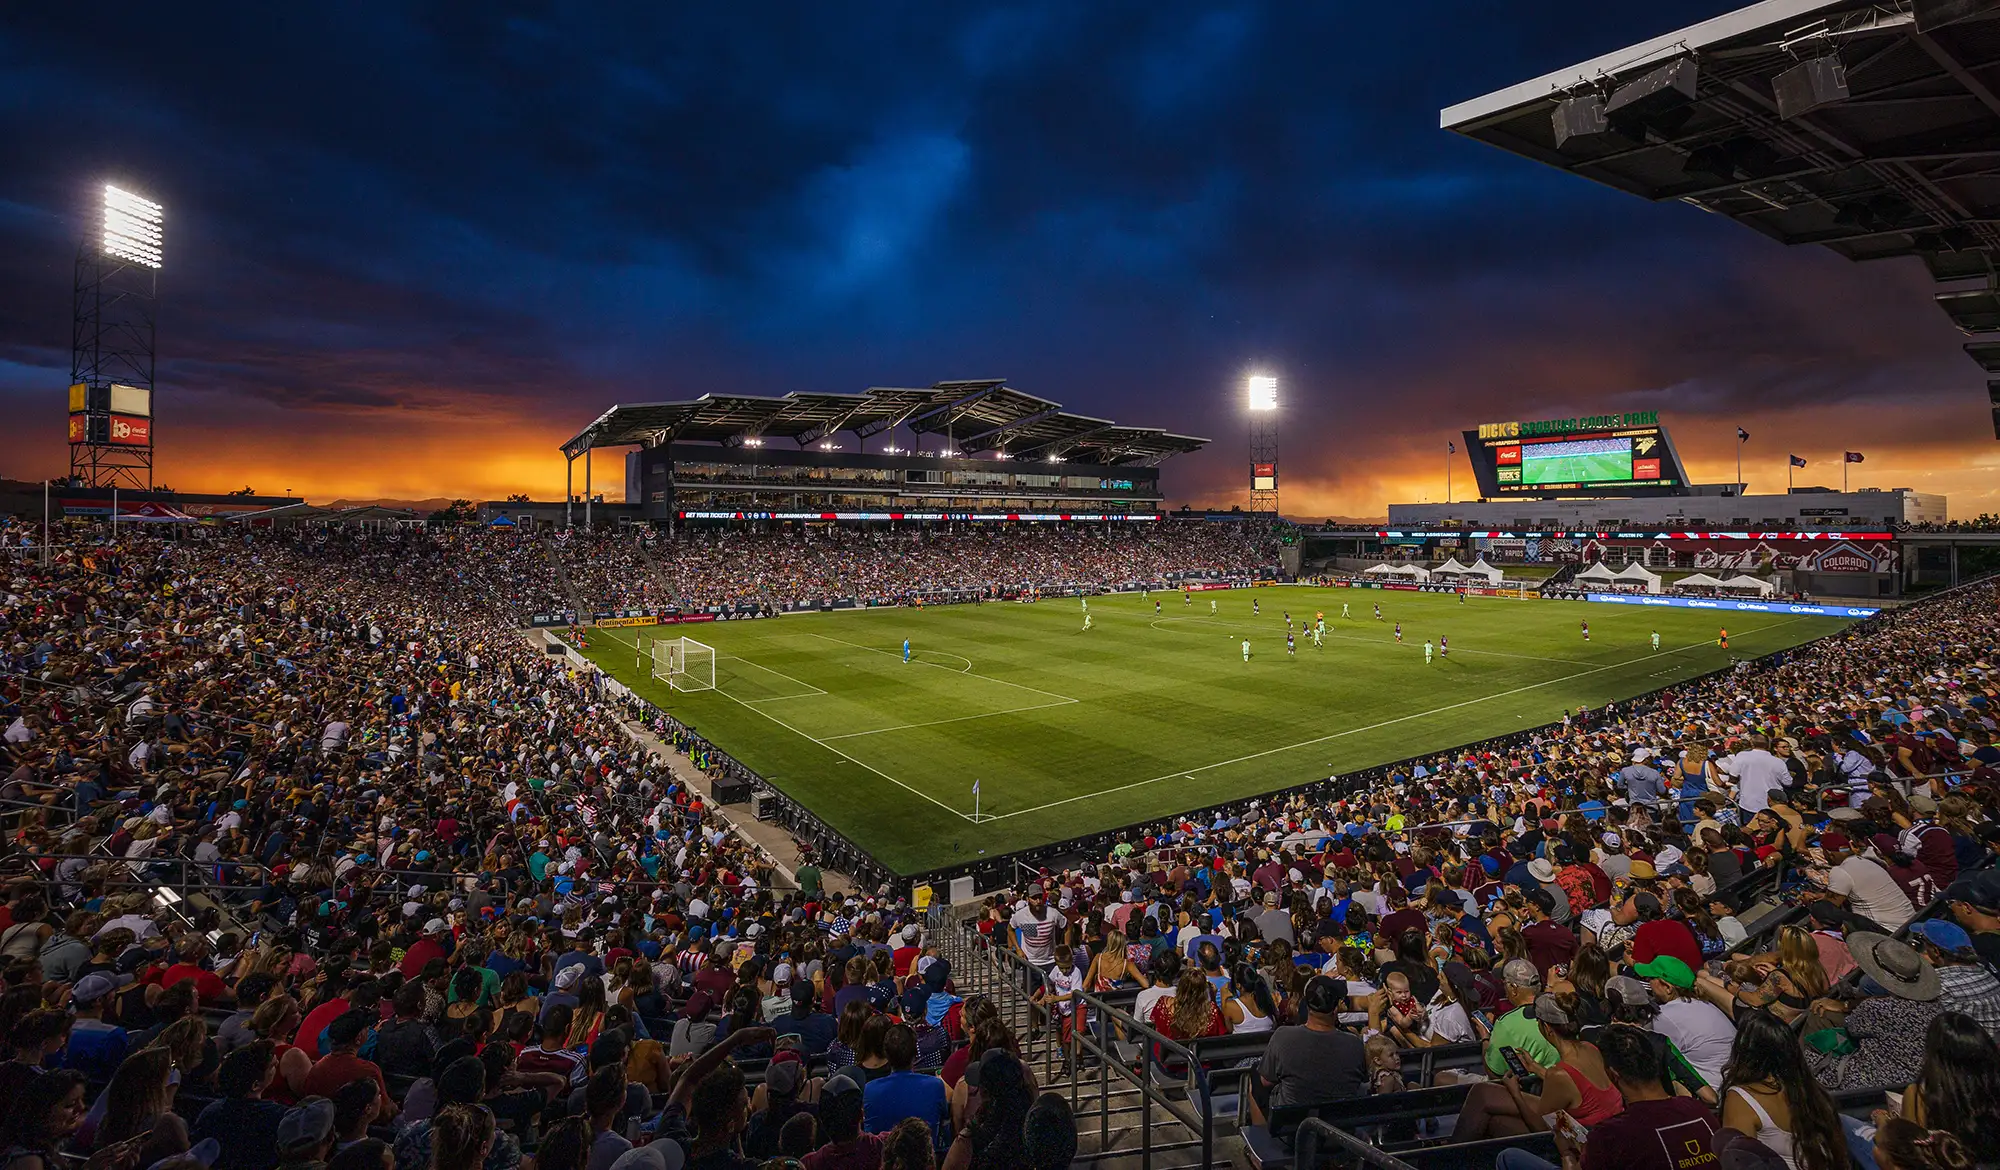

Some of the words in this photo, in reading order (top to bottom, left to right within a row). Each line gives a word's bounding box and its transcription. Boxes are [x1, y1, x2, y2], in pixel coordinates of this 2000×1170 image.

[1478, 421, 1520, 439] DICK'S
[1521, 418, 1577, 435] SPORTING
[1579, 413, 1621, 430] GOODS
[1624, 410, 1659, 427] PARK
[1504, 549, 1524, 558] RAPIDS
[1823, 557, 1868, 569] COLORADO
[598, 619, 635, 628] Continental
[1678, 1152, 1718, 1169] BRIXTON
